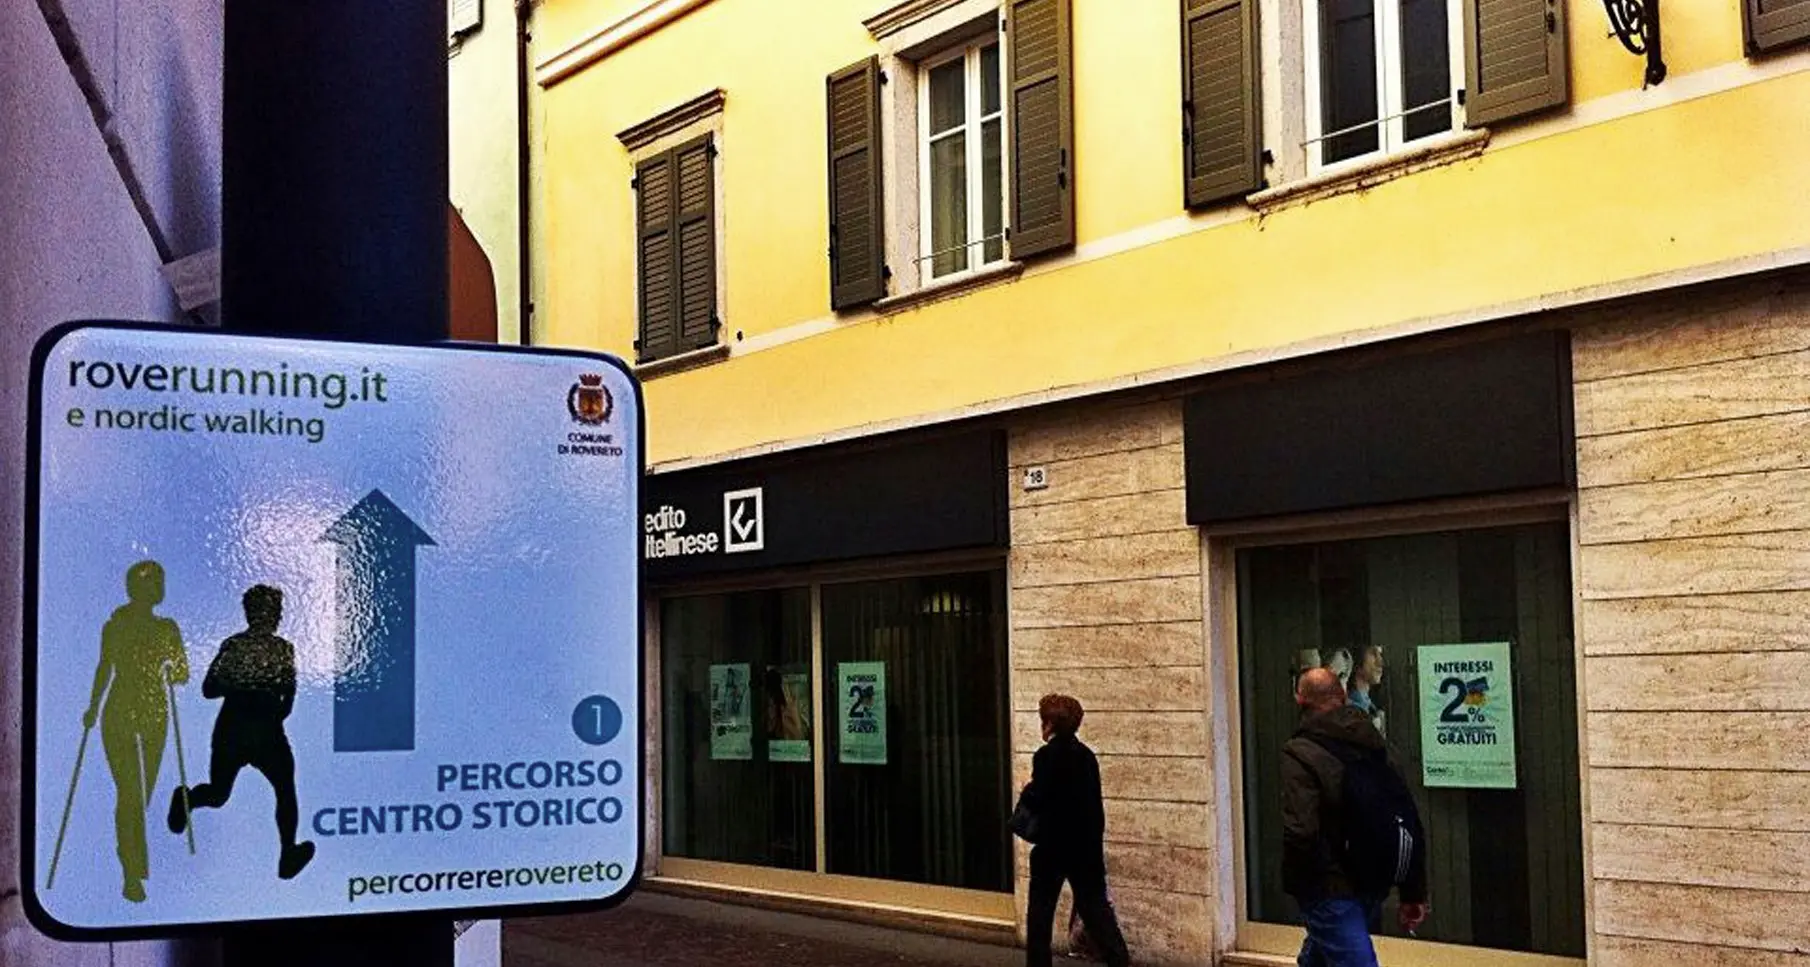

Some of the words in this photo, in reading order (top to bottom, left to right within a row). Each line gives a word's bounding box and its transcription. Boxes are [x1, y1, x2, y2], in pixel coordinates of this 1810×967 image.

[68, 360, 388, 409] roverunning.it
[66, 407, 85, 427] e
[95, 405, 195, 432] nordic
[205, 408, 324, 443] walking
[567, 432, 613, 444] COMUNE
[557, 444, 569, 454] DI
[571, 445, 623, 456] ROVERETO
[1434, 661, 1494, 673] INTERESSI
[592, 704, 602, 736] 1
[1437, 732, 1497, 745] GRATUITI
[437, 759, 623, 792] PERCORSO
[313, 803, 463, 836] CENTRO
[472, 797, 623, 829] STORICO
[349, 861, 623, 902] percorrererovereto
